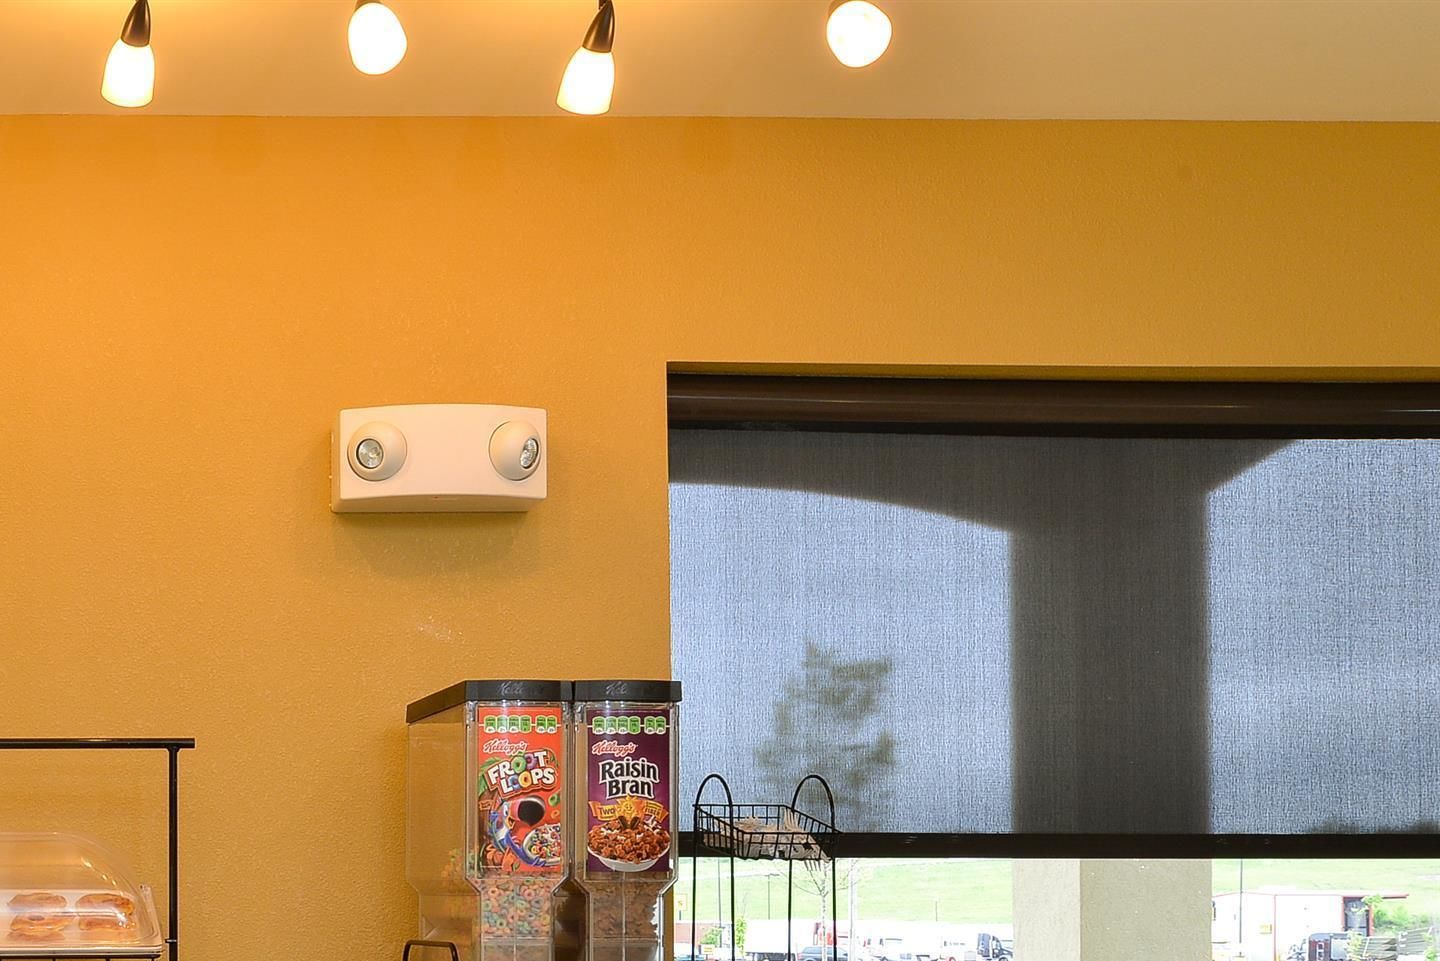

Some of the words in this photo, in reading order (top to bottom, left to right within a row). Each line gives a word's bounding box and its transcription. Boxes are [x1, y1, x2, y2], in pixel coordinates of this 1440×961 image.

[591, 739, 637, 757] Kellogg's
[487, 751, 547, 785] FROOT
[500, 767, 555, 794] LOOPS
[599, 756, 660, 784] Raisin
[606, 779, 655, 799] Bran
